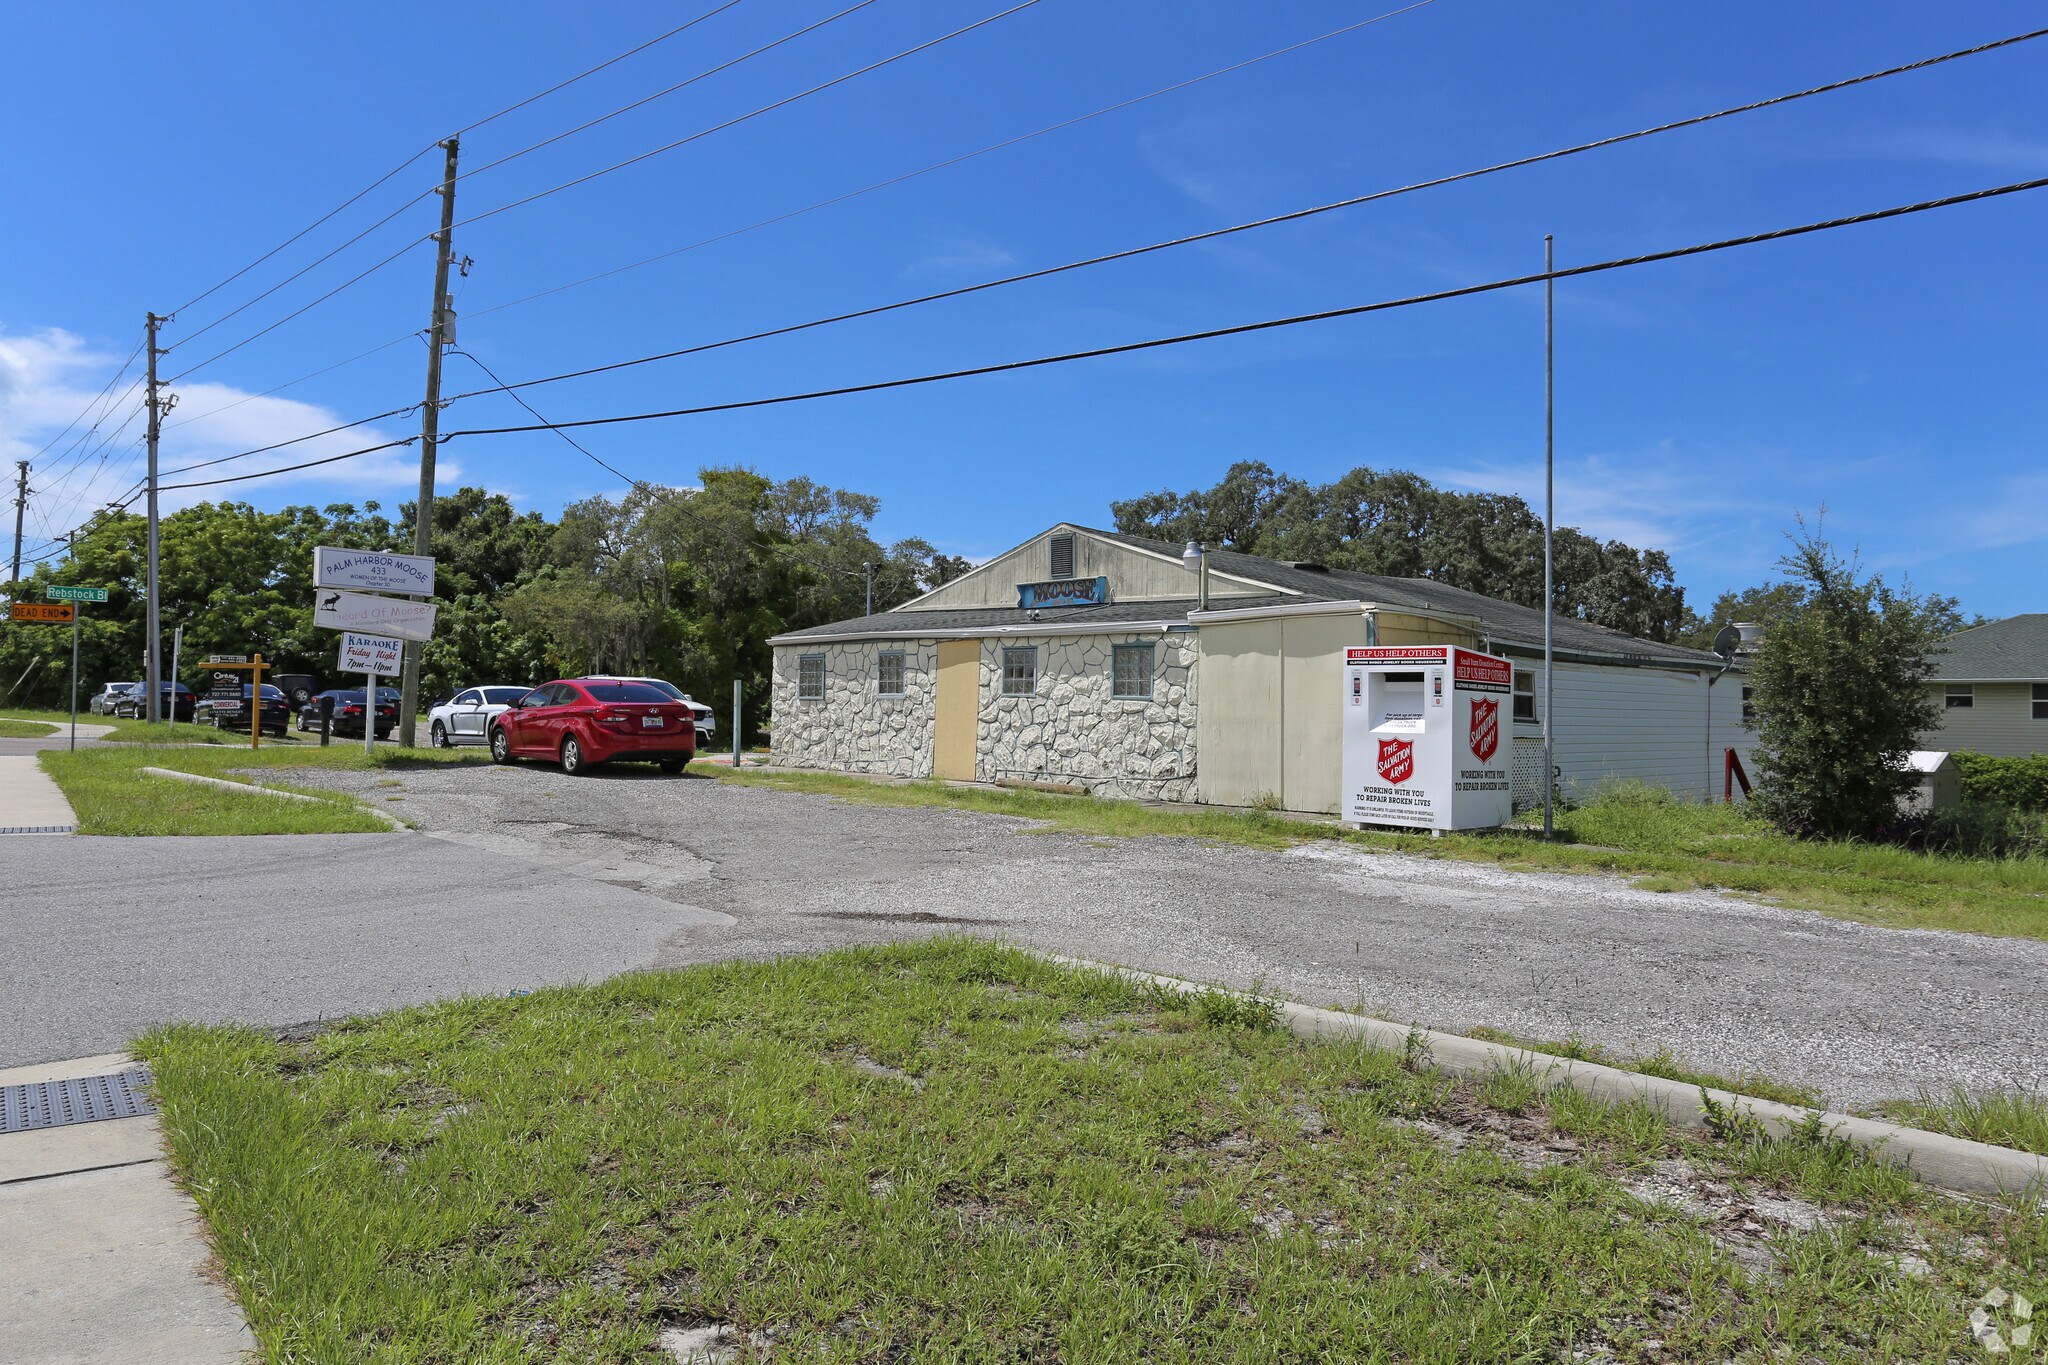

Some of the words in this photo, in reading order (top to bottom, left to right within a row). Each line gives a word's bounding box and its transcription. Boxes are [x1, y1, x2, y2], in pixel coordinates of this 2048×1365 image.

[326, 559, 353, 575] PALM
[354, 556, 393, 567] HARBOR
[394, 560, 429, 583] MOOSE
[370, 566, 387, 576] 433
[48, 587, 94, 599] Rebstock
[1033, 580, 1096, 602] MOOSE
[14, 607, 38, 617] DEAD
[42, 608, 60, 618] END
[371, 607, 386, 618] Of
[390, 605, 432, 617] Moose?
[347, 635, 399, 652] KARAOKE
[346, 646, 371, 659] Friday
[375, 650, 397, 660] Night
[1406, 649, 1442, 657] OTHERS
[1460, 657, 1470, 665] Small
[1456, 666, 1470, 678] HELP
[1471, 667, 1478, 679] US
[1478, 668, 1490, 680] HELP
[1491, 669, 1509, 682] OTHERS
[1475, 703, 1488, 724] THE
[1470, 706, 1497, 748] SALVATION
[1480, 726, 1496, 756] ARMY
[1383, 742, 1398, 757] THE
[1378, 744, 1411, 773] SALVATION
[1389, 759, 1410, 780] ARMY
[1461, 770, 1483, 779] WORKING
[1484, 770, 1496, 779] WITH
[1496, 770, 1505, 779] YOU
[1363, 786, 1393, 795] WORKING
[1394, 788, 1411, 797] WITH
[1455, 782, 1462, 791] TO
[1463, 782, 1479, 791] REPAIR
[1480, 782, 1498, 791] BROKEN
[1498, 782, 1510, 791] LIVES
[1366, 794, 1388, 803] REPAIR
[1388, 796, 1413, 806] BROKEN
[1414, 799, 1431, 807] LIVES
